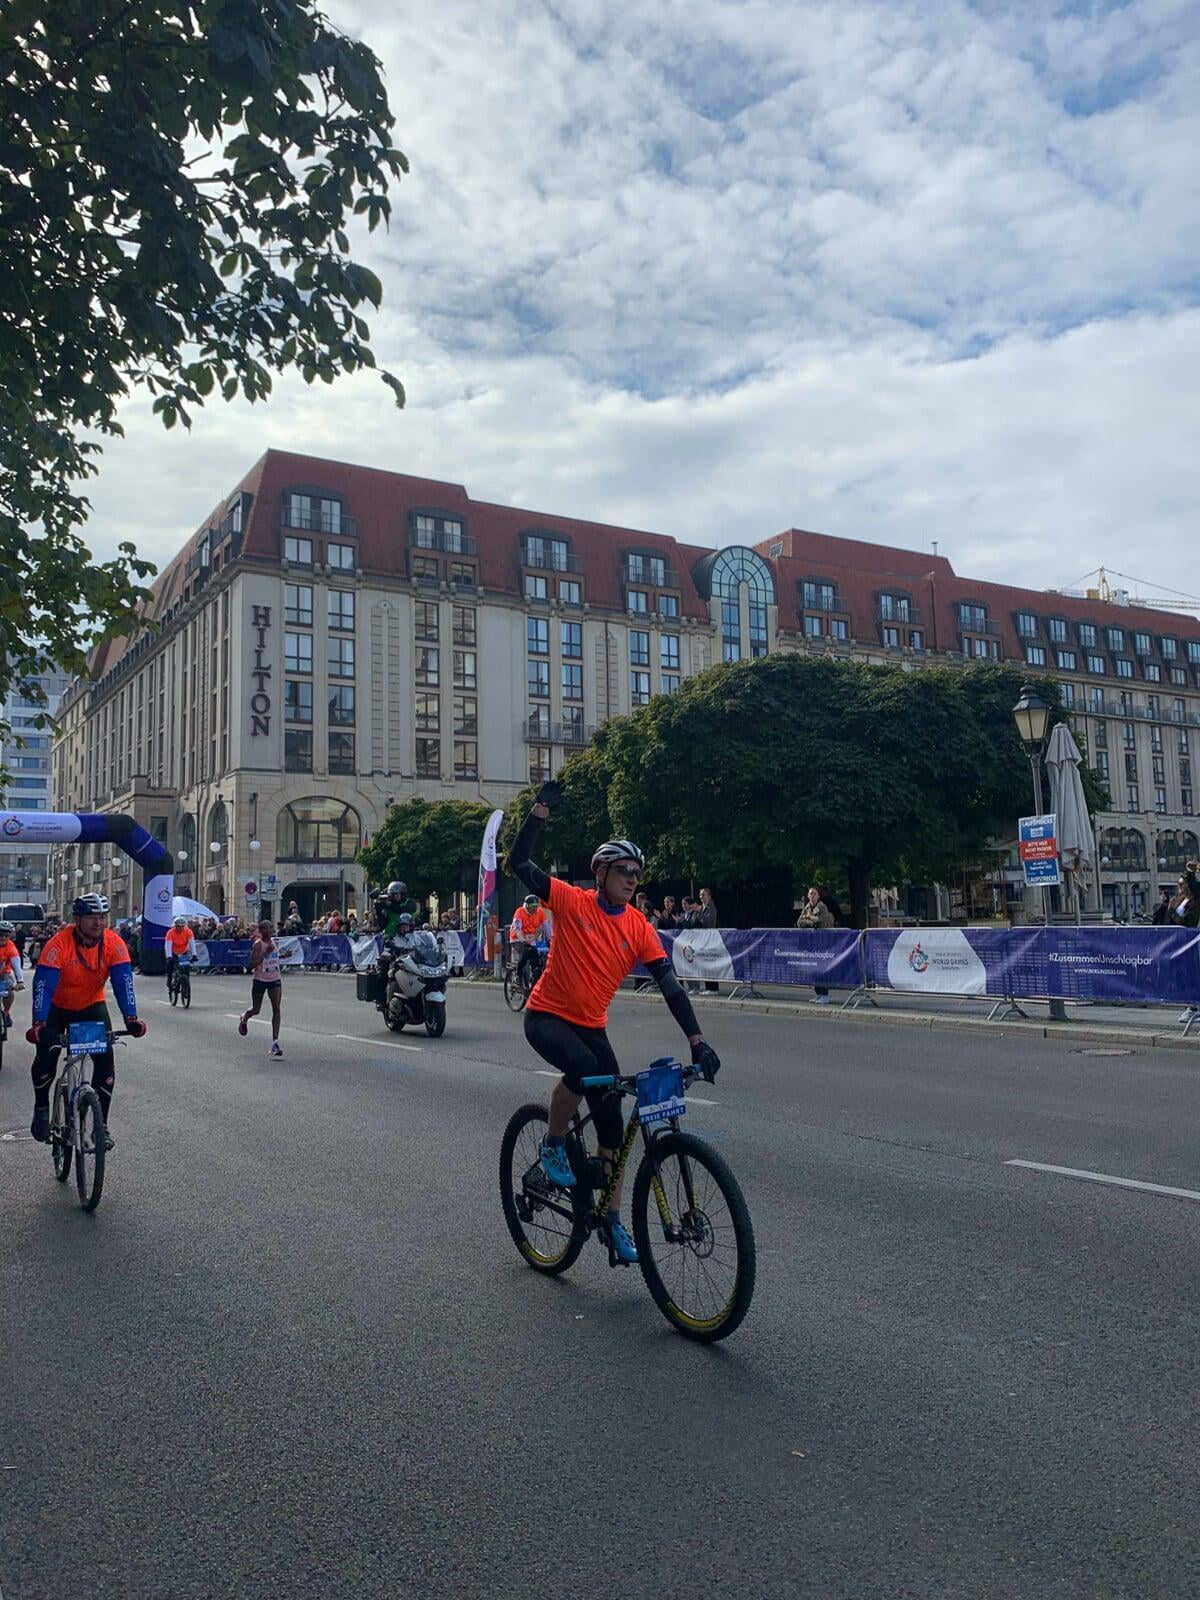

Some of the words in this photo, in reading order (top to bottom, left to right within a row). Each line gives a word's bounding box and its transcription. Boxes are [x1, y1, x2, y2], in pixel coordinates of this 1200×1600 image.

[251, 605, 272, 736] HILTON
[950, 958, 969, 966] GAMES
[1049, 952, 1153, 967] #ZusammenUnschlagbar
